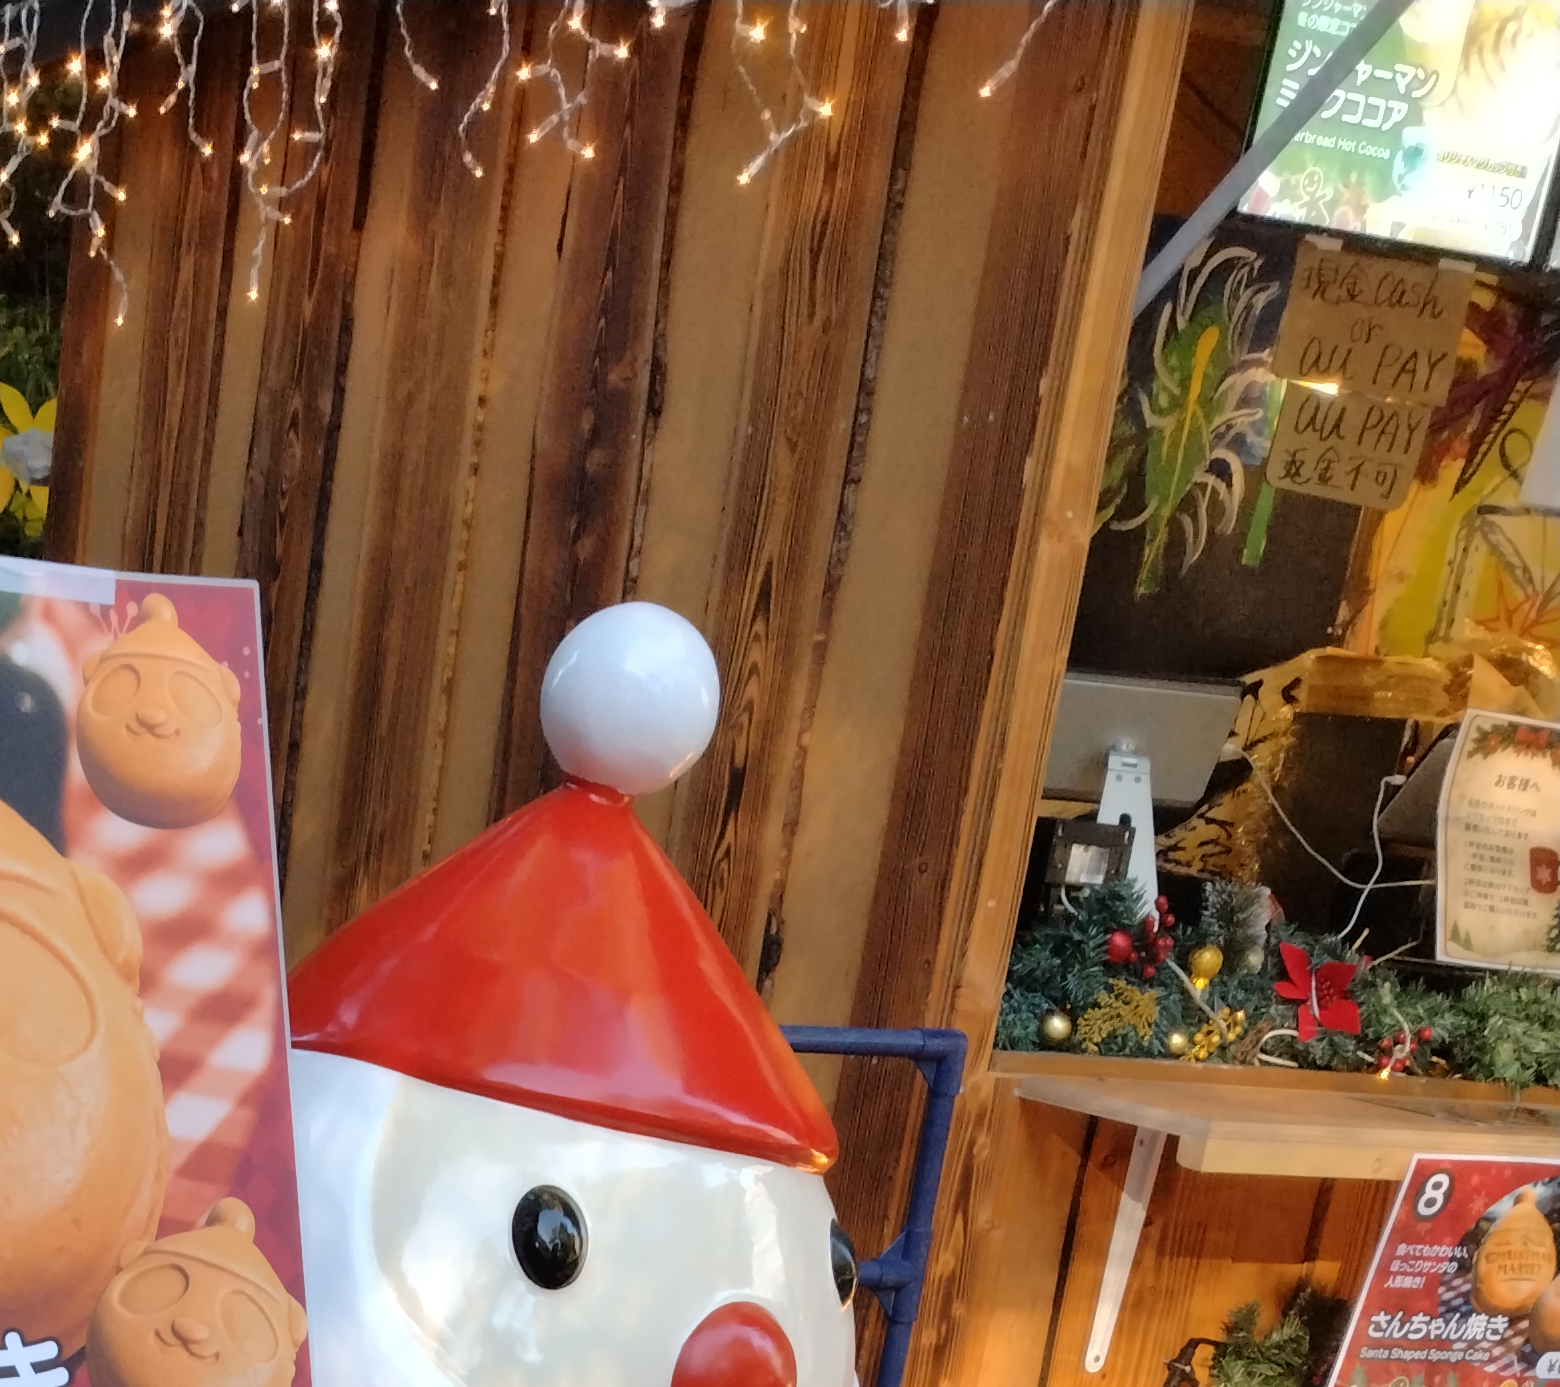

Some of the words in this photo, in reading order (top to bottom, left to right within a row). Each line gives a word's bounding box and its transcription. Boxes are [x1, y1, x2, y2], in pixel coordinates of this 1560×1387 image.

[1286, 39, 1440, 98] ジンャーマン
[1276, 78, 1409, 131] ミクココア
[1337, 137, 1356, 152] Hot
[1358, 141, 1390, 159] Cocoa
[1351, 316, 1383, 344] or
[1371, 344, 1449, 393] PAY
[1356, 404, 1424, 455] PAY
[1417, 1172, 1450, 1217] 8
[1368, 1309, 1509, 1341] さんちゃん焼き
[1359, 1346, 1389, 1359] Santa
[1389, 1347, 1428, 1361] Shaped
[1428, 1348, 1464, 1363] Sponge
[1465, 1348, 1490, 1361] Cake
